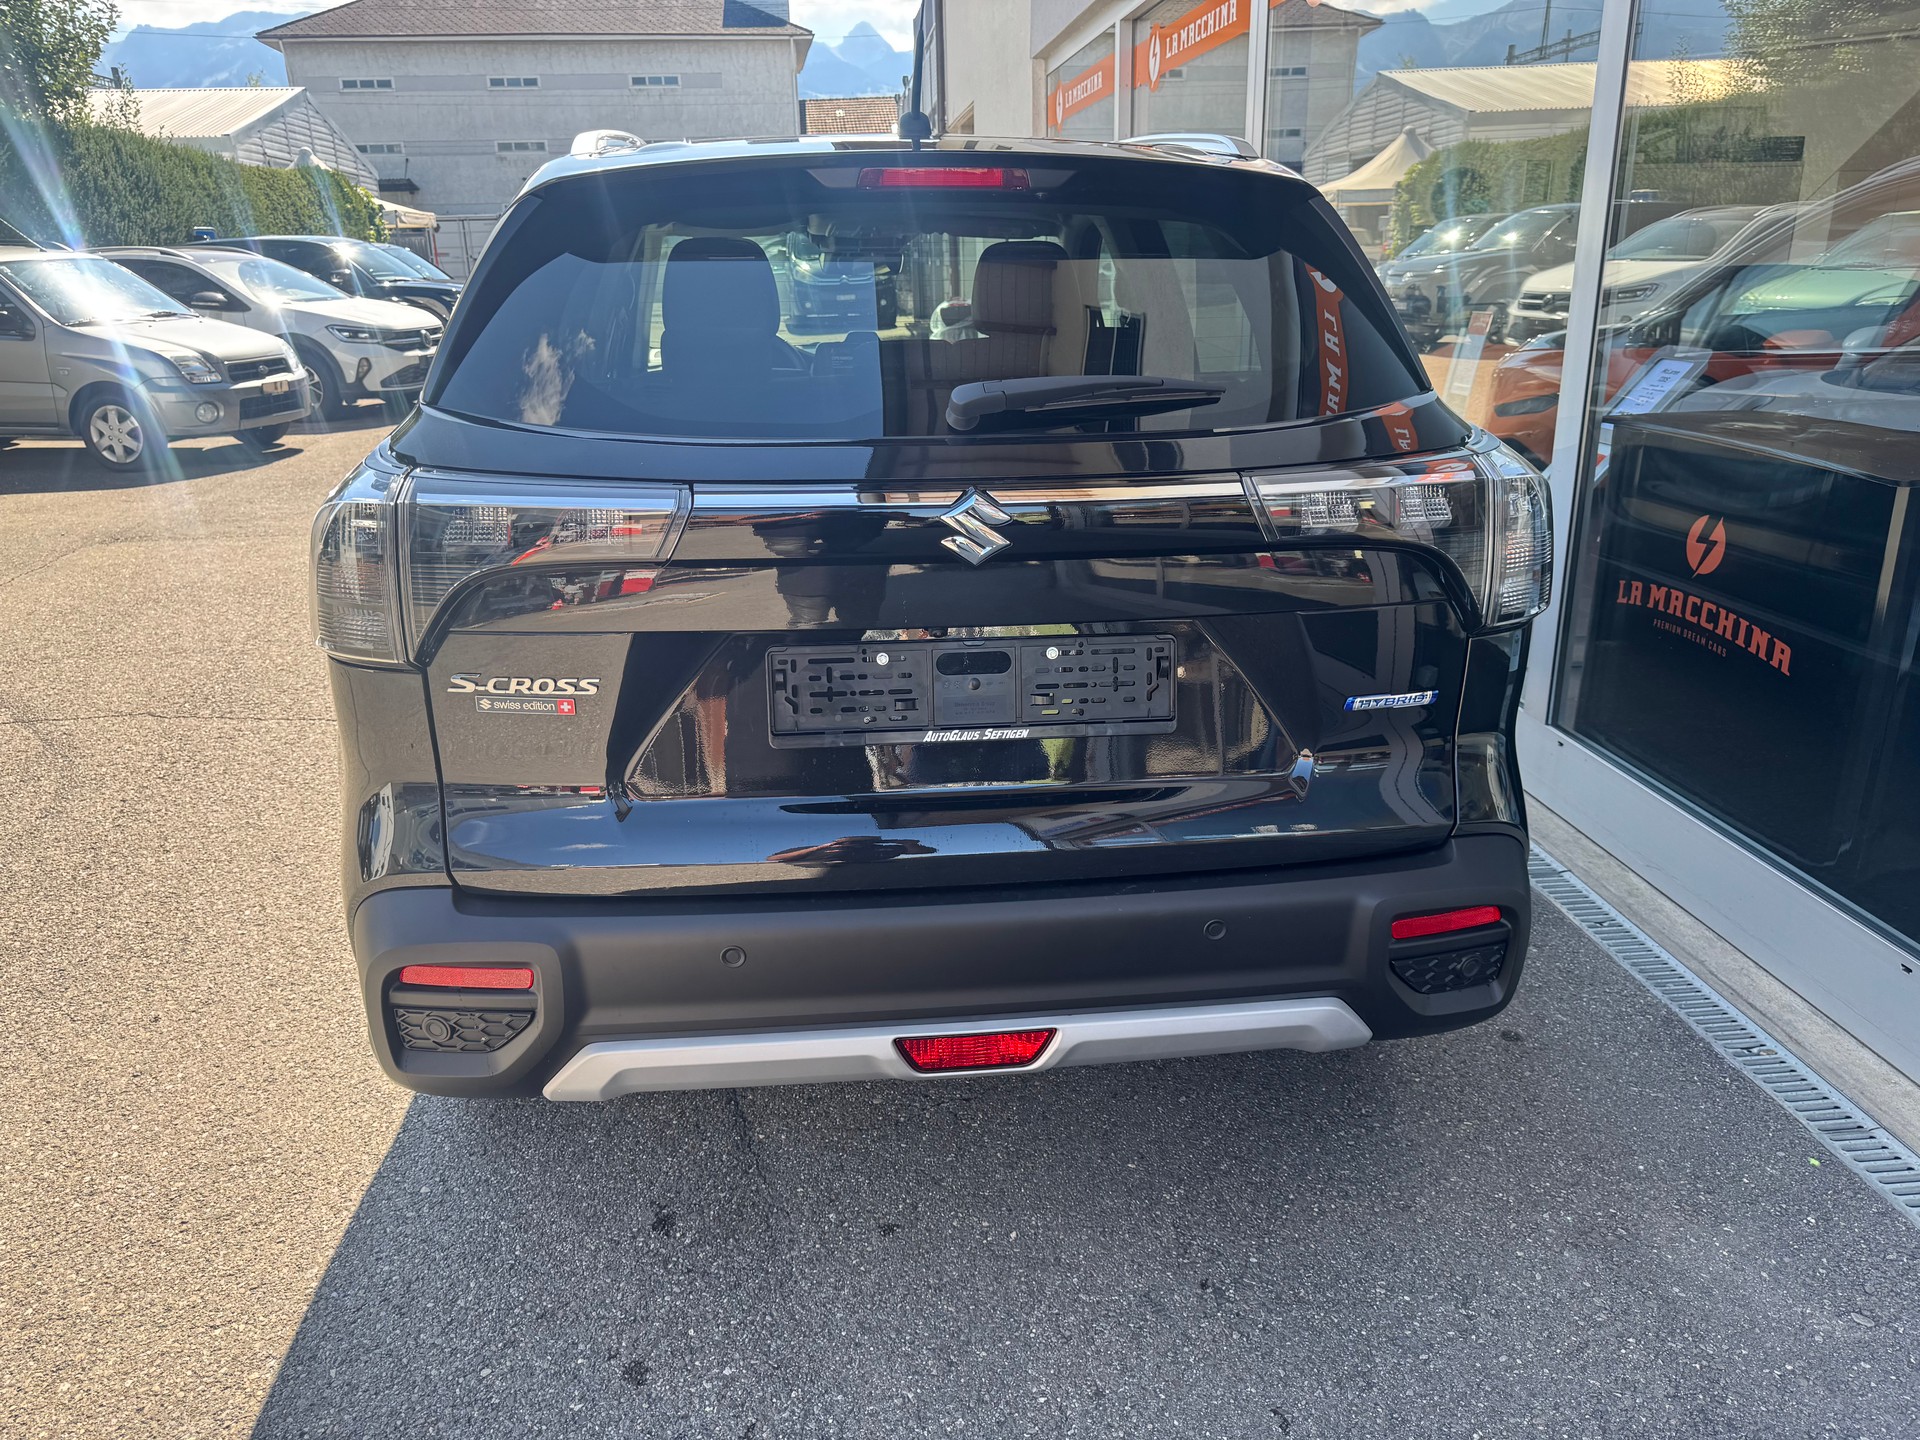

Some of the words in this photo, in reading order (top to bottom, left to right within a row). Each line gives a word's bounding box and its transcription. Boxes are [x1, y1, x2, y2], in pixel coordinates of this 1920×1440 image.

[1166, 33, 1178, 59] LA
[1179, 0, 1237, 51] MACCHINA
[1616, 579, 1642, 606] LA
[1647, 583, 1793, 677] MACCHINA
[1652, 618, 1682, 635] PREMIUM
[1683, 628, 1706, 646] DREAM
[1708, 640, 1727, 658] CARS
[446, 672, 601, 695] S-CROSS
[493, 700, 521, 710] swiss
[522, 701, 556, 711] edition
[1360, 695, 1425, 708] HYBRID
